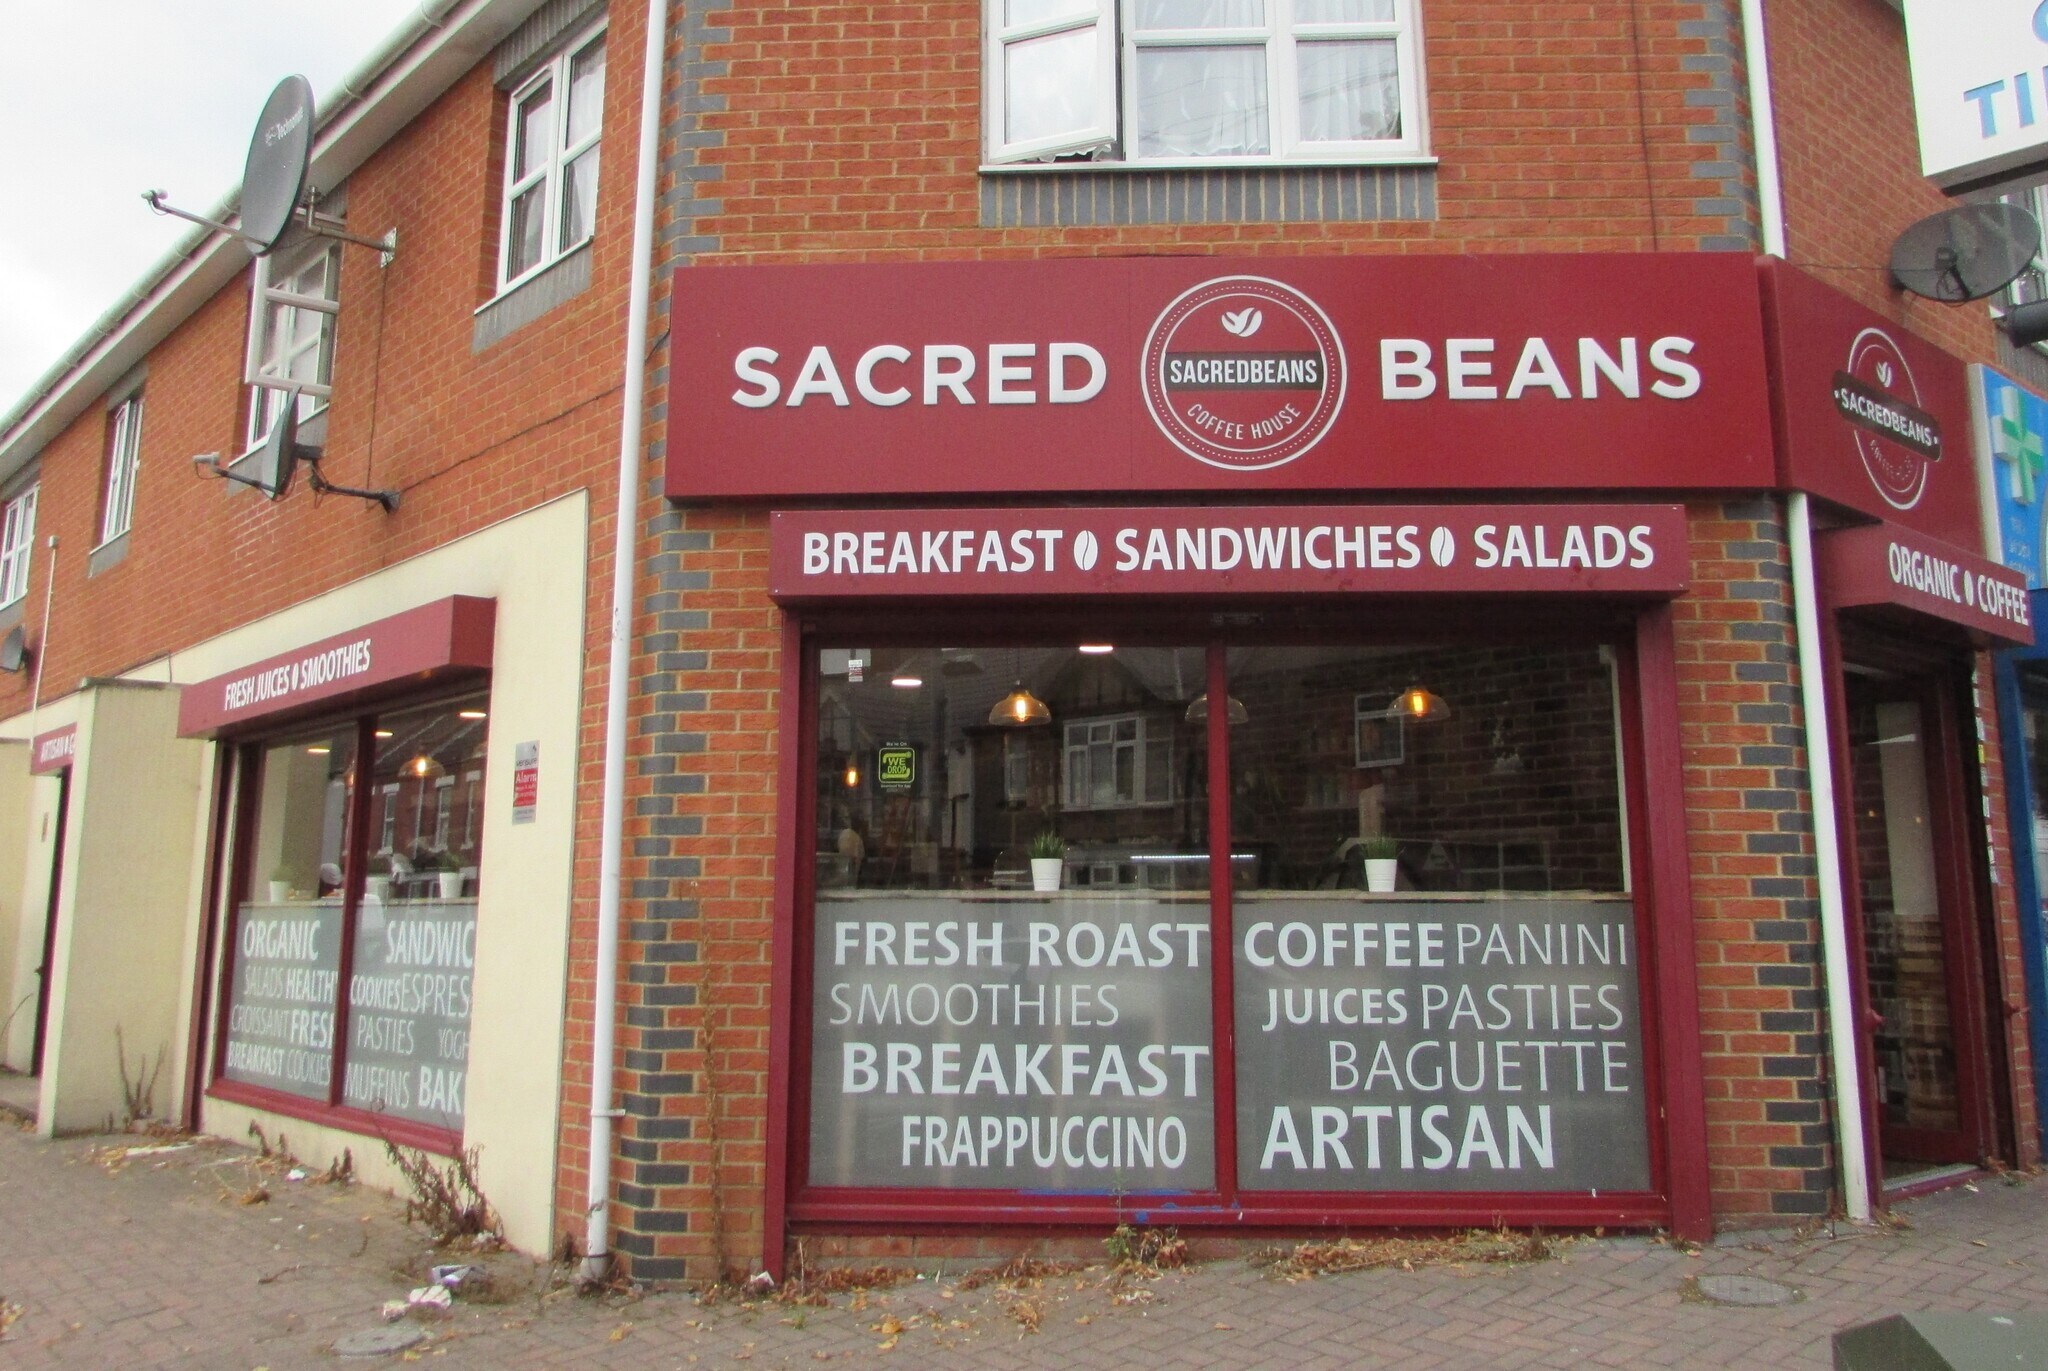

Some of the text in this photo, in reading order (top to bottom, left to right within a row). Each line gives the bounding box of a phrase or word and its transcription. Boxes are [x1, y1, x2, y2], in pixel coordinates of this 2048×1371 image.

[1964, 65, 2048, 139] TI
[732, 337, 1701, 408] SACRED BEANS
[1170, 360, 1317, 383] SACREDBEANS
[1187, 403, 1301, 440] COFFEE HOUSE
[803, 525, 1654, 574] BREAKFAST SANDWICHES SALADS
[1889, 542, 2028, 626] ORGANIC COFFEE
[225, 638, 371, 711] FRESH JUICES SMOOTHIES
[887, 766, 907, 774] DROP
[888, 757, 906, 765] WE
[244, 920, 321, 961] ORGANIC
[835, 921, 1209, 967] FRESH ROAST
[1244, 922, 1628, 967] COFFEE PANINI
[244, 965, 284, 998] SALADS
[351, 974, 401, 1010] COOKIES
[830, 982, 1119, 1026] SMOOTHIES
[231, 1004, 290, 1038] CROISSANT
[1262, 984, 1623, 1031] JUICES PASTIES
[357, 1014, 415, 1055] PASTIES
[227, 1041, 331, 1085] BREAKFAST COOKIES
[344, 1062, 410, 1109] MUFFINS
[842, 1042, 1209, 1096] BREAKFAST
[1329, 1040, 1629, 1092] BAGUETTE
[902, 1116, 1187, 1168] FRAPPUCCINO
[1260, 1105, 1554, 1169] ARTISAN
